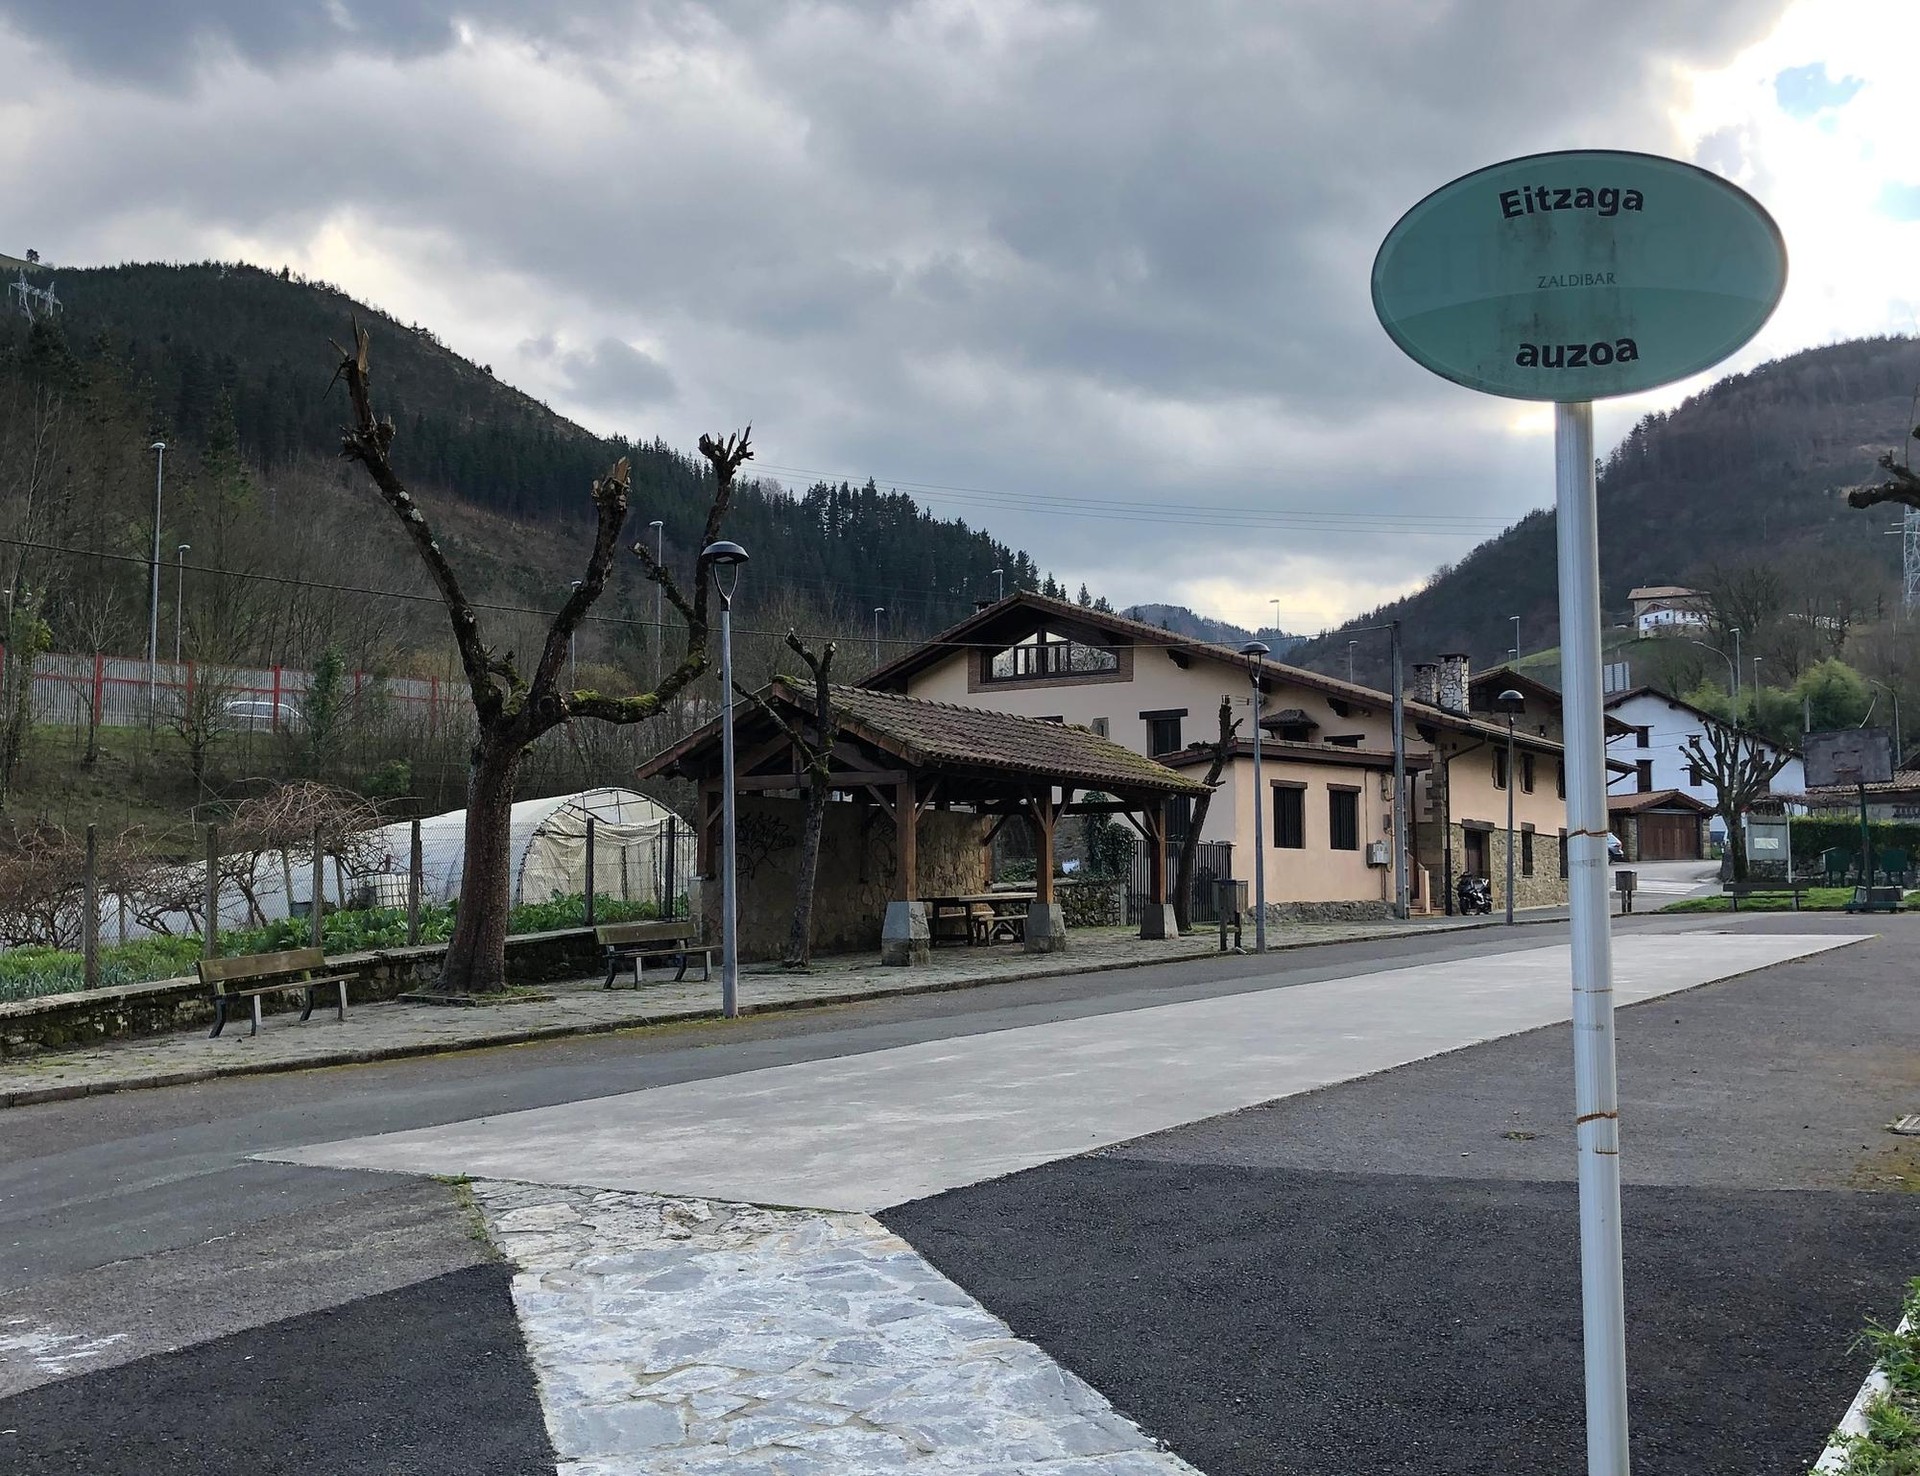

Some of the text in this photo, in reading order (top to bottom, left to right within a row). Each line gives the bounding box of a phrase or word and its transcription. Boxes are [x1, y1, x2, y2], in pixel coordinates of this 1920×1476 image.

[1500, 187, 1644, 218] Eitzaga
[1538, 272, 1617, 289] ZALDIBAR
[1516, 338, 1639, 368] auzoa
